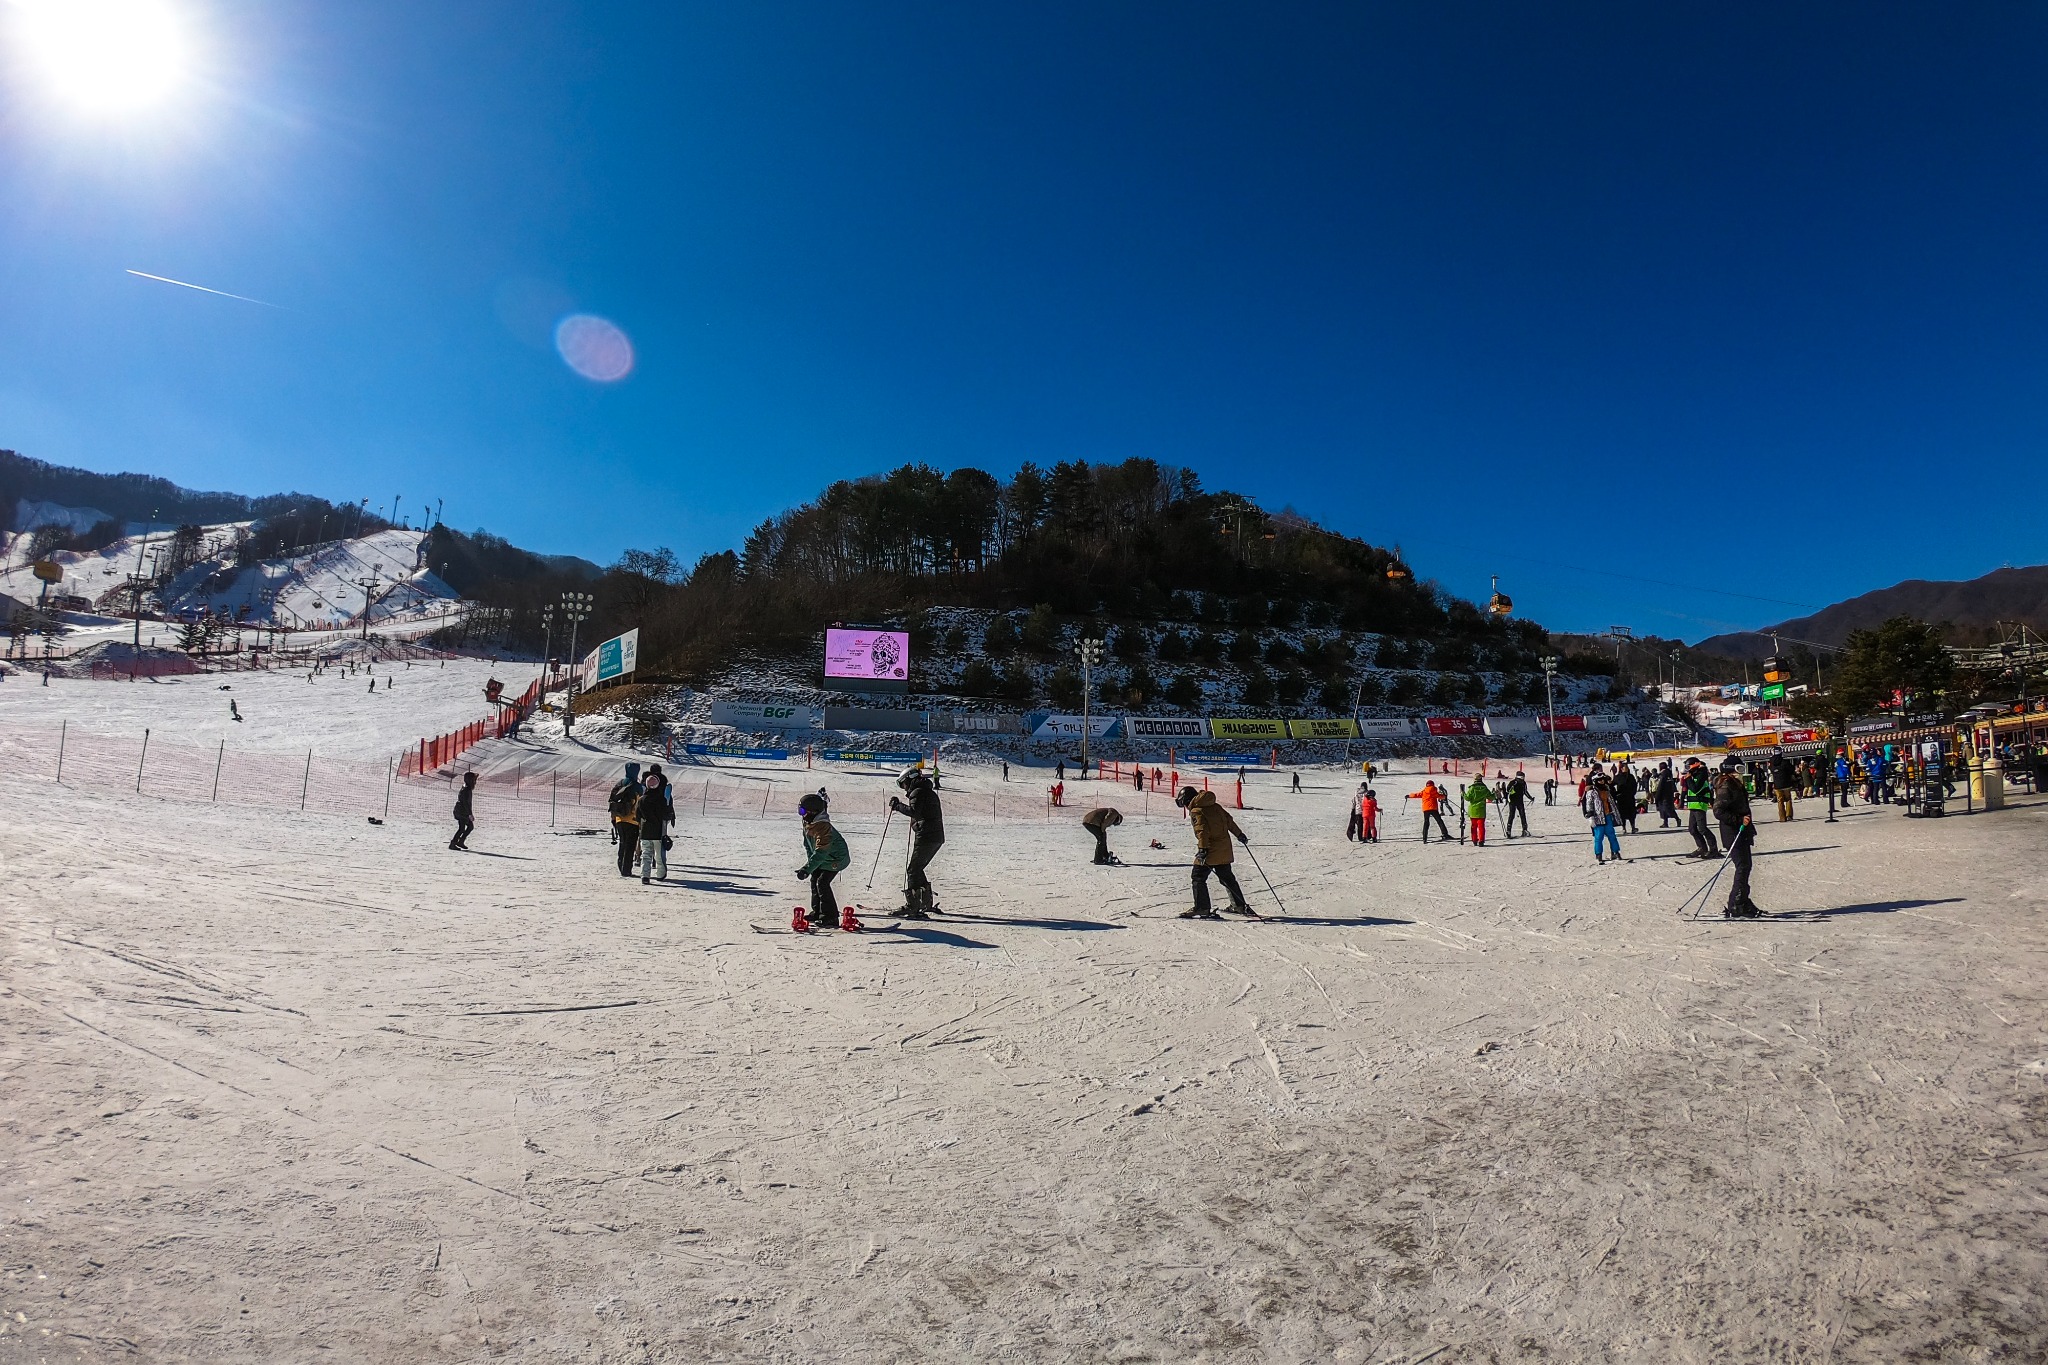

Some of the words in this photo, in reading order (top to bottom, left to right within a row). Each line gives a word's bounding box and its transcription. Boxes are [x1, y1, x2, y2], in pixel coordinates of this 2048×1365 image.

[762, 706, 796, 719] BGF
[953, 717, 999, 730] FUBU
[1451, 720, 1466, 729] 35%
[1607, 716, 1620, 724] BGF
[1135, 722, 1201, 734] MEGABOX
[1221, 723, 1278, 735] 캐시슬라이드
[1312, 728, 1350, 736] 캐시슬라이드
